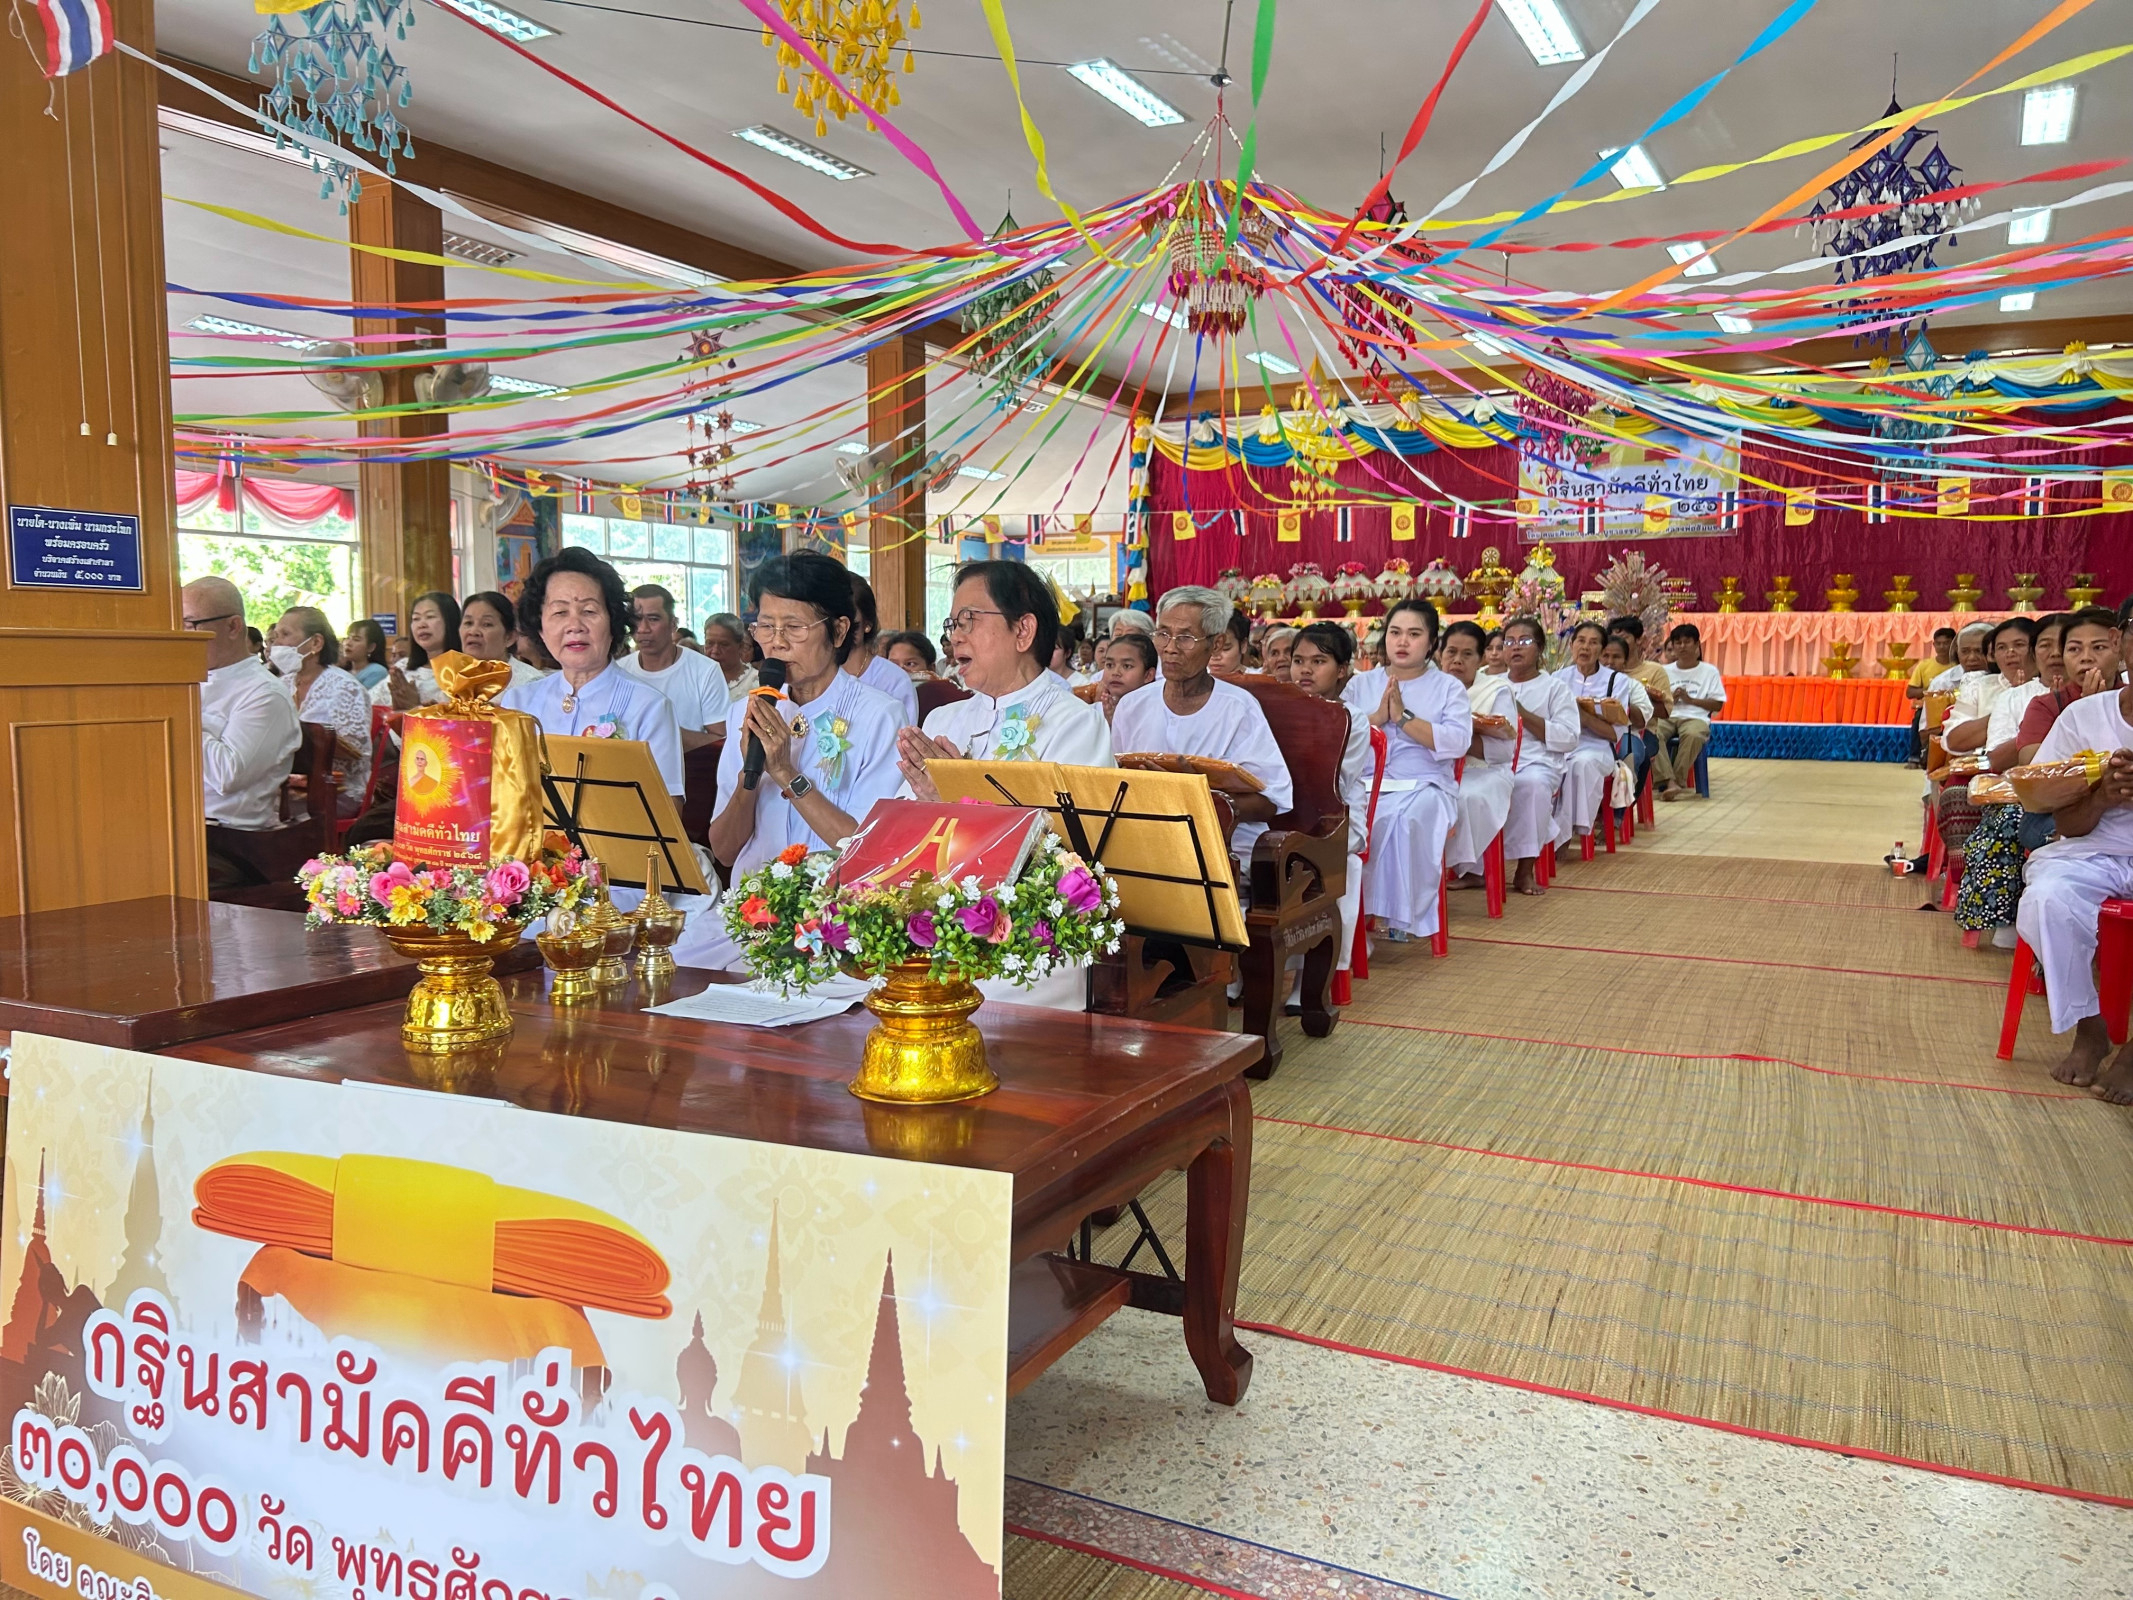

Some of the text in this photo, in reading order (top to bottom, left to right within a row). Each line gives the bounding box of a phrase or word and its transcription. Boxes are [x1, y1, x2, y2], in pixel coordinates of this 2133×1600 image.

[1677, 498, 1718, 513] ๒๕๖
[44, 535, 110, 551] พร้อมครอบครัว
[87, 1299, 820, 1562] กฐินสามัคคีทั่วไทย
[20, 1421, 238, 1543] ๓๐,๐๐๐
[258, 1493, 314, 1571] วัด
[26, 1532, 70, 1583] โดย
